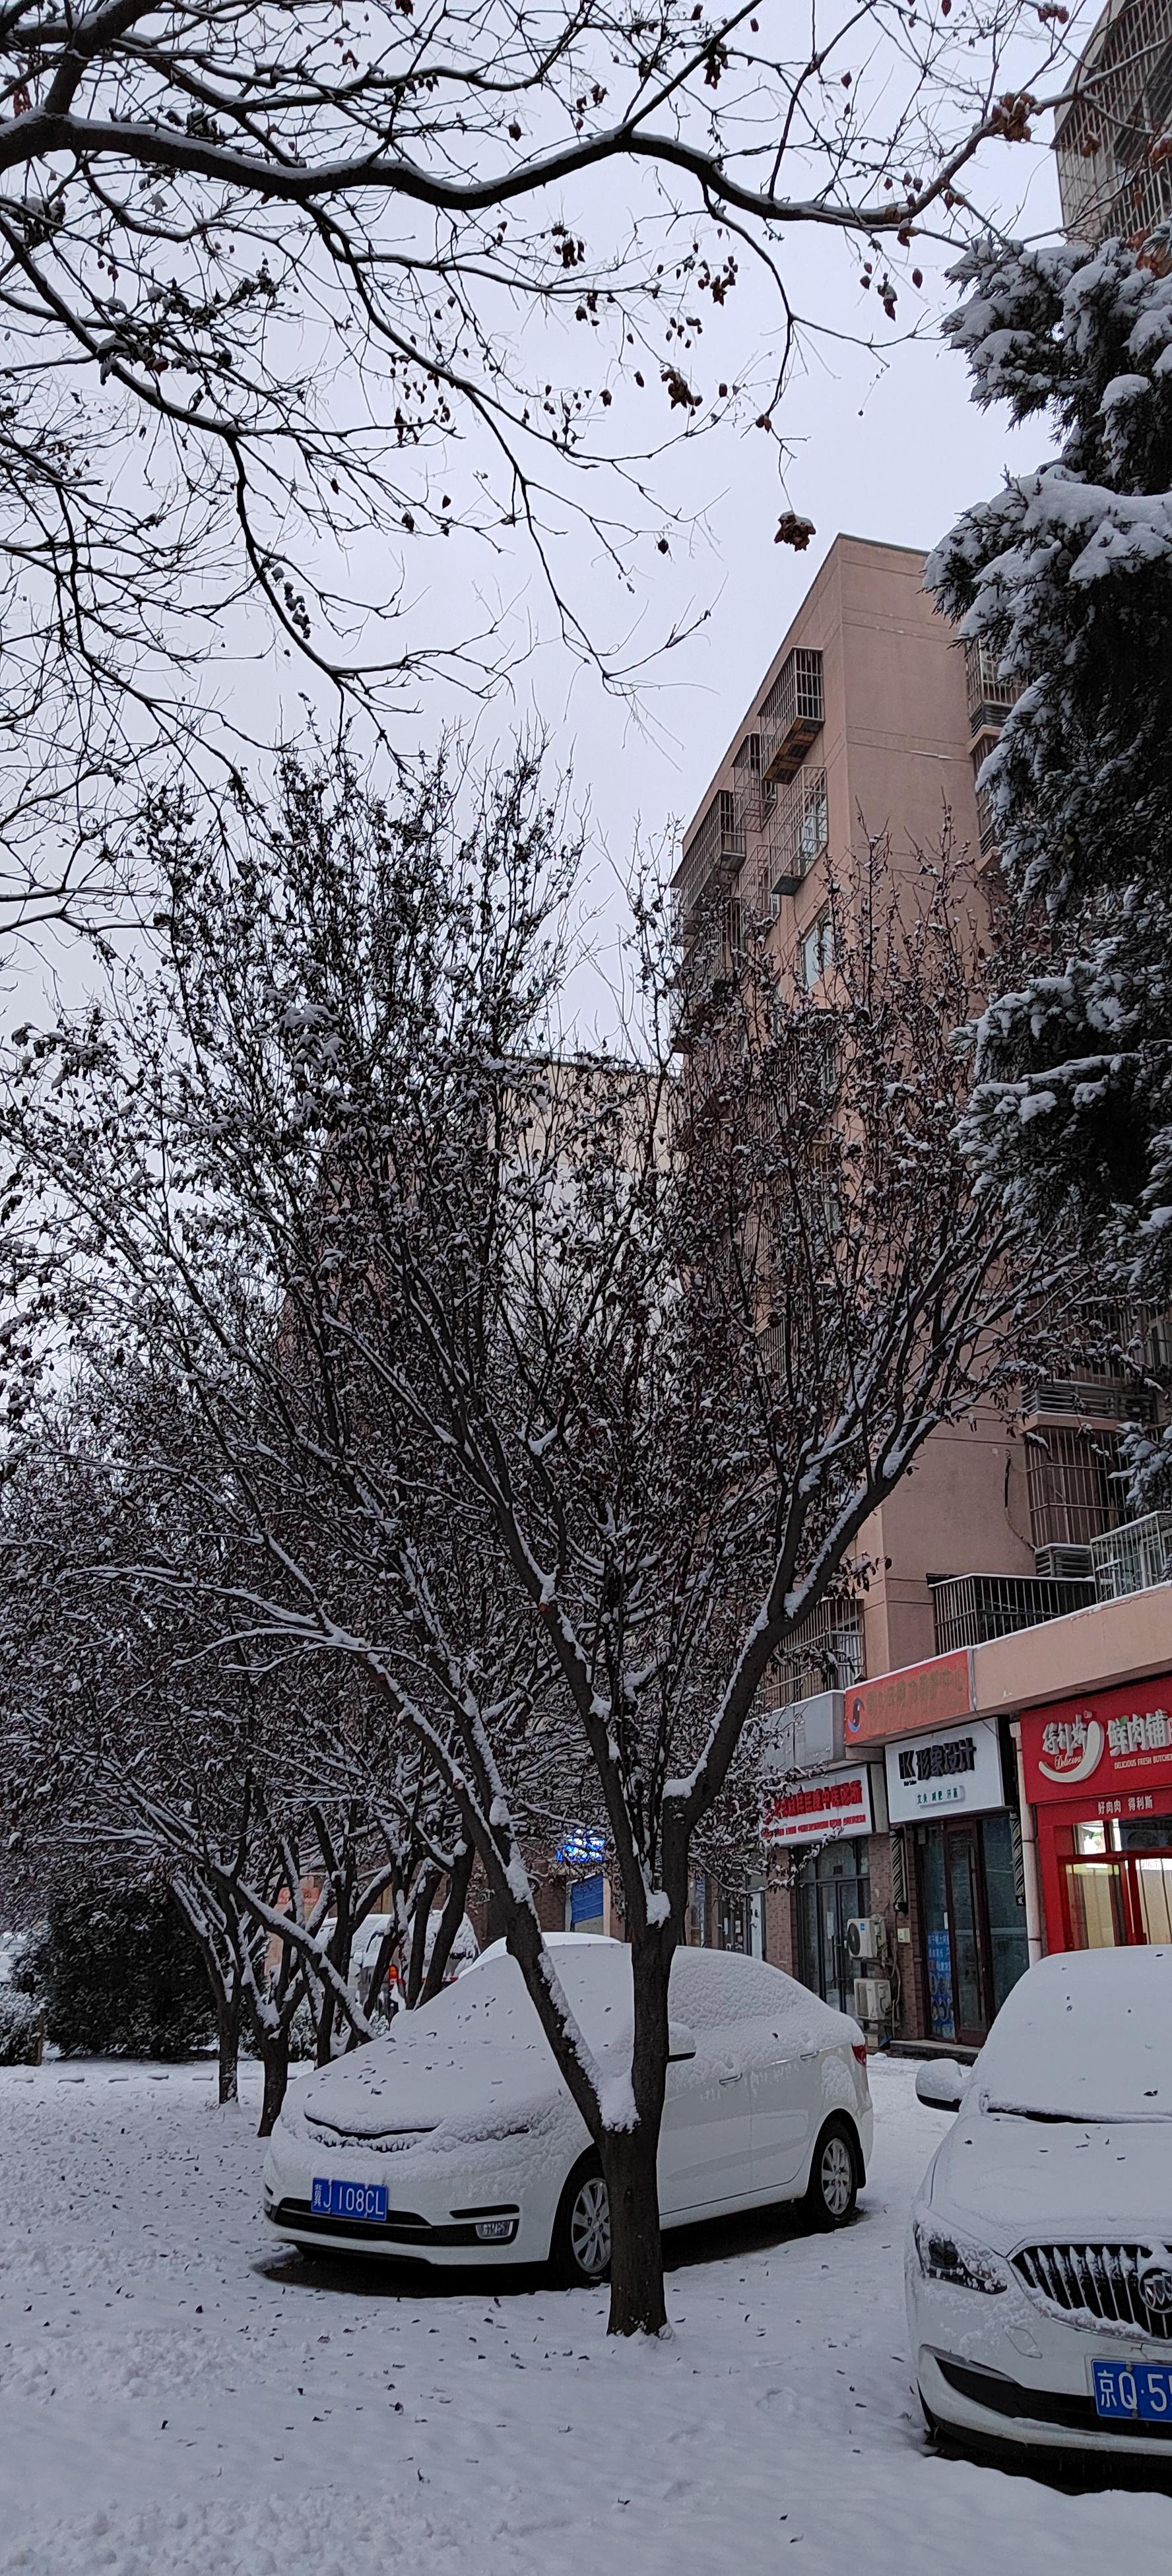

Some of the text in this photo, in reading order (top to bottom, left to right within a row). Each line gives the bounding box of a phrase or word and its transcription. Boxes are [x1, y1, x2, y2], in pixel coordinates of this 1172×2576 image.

[1107, 1709, 1167, 1756] 鲜肉铺
[916, 1737, 977, 1780] 形象设计
[1114, 1758, 1137, 1770] DELICIOUS
[1137, 1756, 1152, 1766] FRESH
[1097, 1795, 1153, 1815] 好肉肉 得利斯
[1097, 2369, 1172, 2412] 京Q·5
